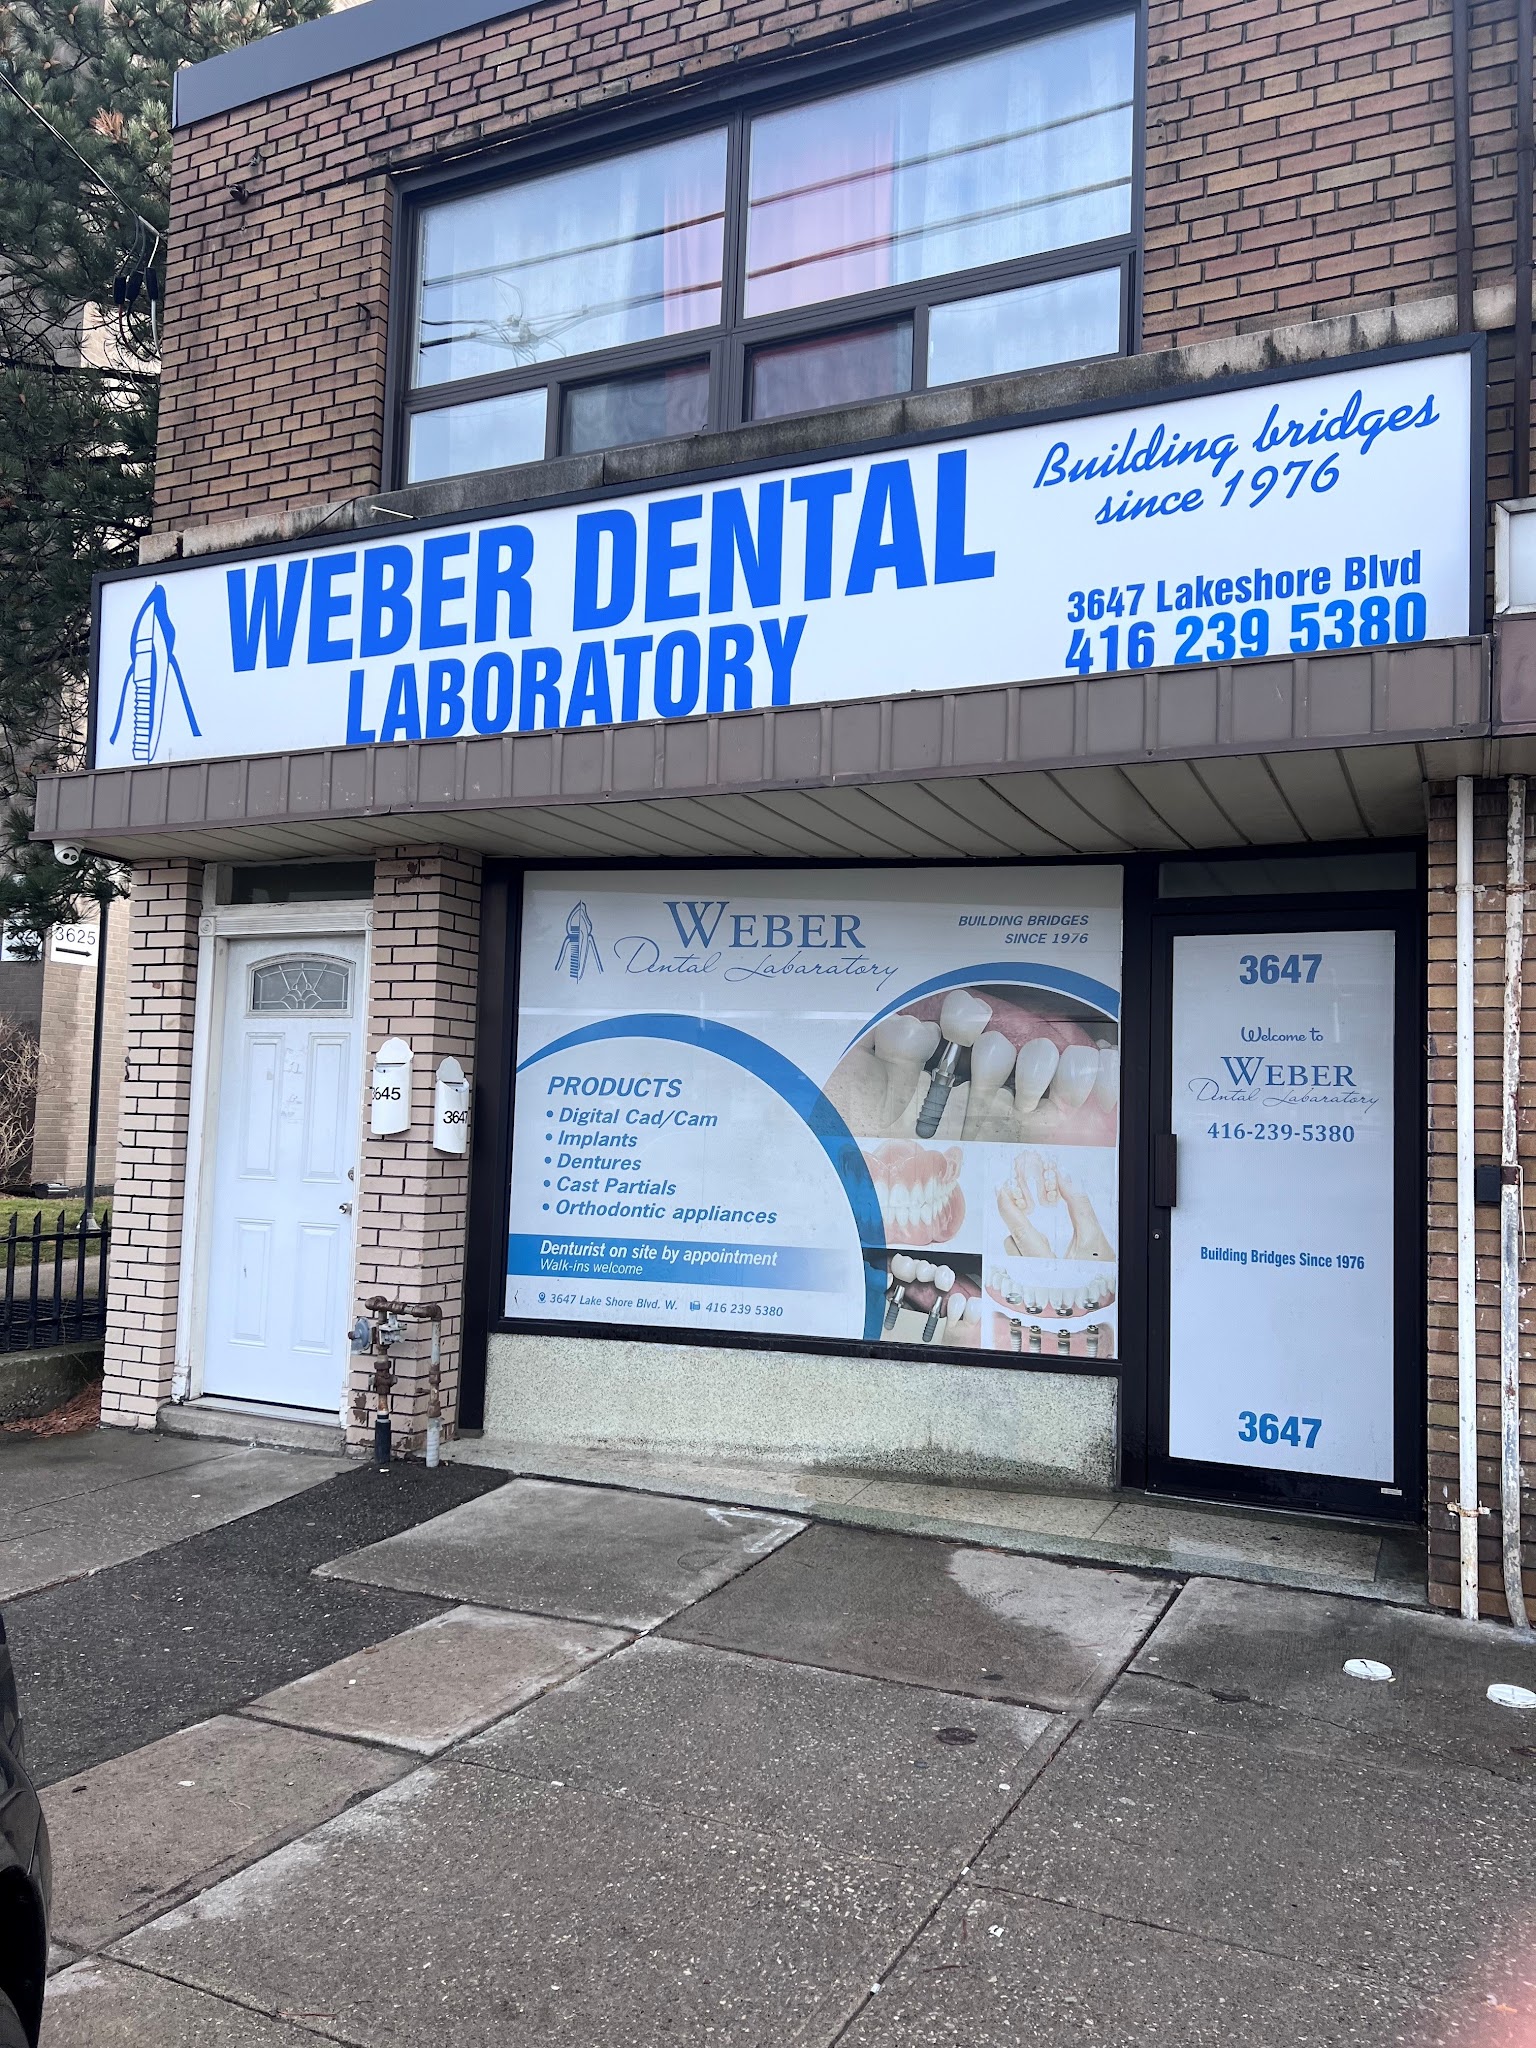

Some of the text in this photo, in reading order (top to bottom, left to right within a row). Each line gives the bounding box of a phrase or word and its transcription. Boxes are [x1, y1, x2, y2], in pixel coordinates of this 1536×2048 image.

[1033, 389, 1440, 489] Building bridges
[1095, 452, 1340, 525] since 1976
[226, 448, 996, 672] WEBER DENTAL
[1067, 548, 1421, 623] 3647 Lakeshore Blvd
[1065, 591, 1427, 676] 416 239 5380
[346, 614, 808, 745] LABORATORY
[662, 900, 867, 949] WEBER
[957, 915, 1090, 927] BUILDING BRIDGES
[55, 926, 96, 945] 3625
[1004, 932, 1090, 944] SINCE 1976
[613, 935, 722, 974] Dental
[1239, 953, 1323, 985] 3647
[1240, 1026, 1324, 1043] Welcome to
[1220, 1056, 1358, 1088] WEBER
[547, 1075, 683, 1099] PRODUCTS
[1187, 1077, 1262, 1102] Dental
[558, 1107, 719, 1129] Digital Cad/Cam
[557, 1130, 639, 1150] Implants
[1207, 1122, 1355, 1143] 416-239-5380
[557, 1153, 642, 1171] Dentures
[556, 1176, 677, 1196] Cast Partials
[555, 1199, 778, 1224] Orthodontic appliances
[539, 1239, 778, 1267] Denturist on site by appointment
[1200, 1246, 1365, 1270] Building Bridges Since 1976
[539, 1257, 643, 1275] Walk-ins welcome
[549, 1293, 678, 1311] 3647 Lake Shore Blvd. W.
[705, 1302, 784, 1318] 416 239 5380
[1237, 1410, 1323, 1449] 3647
